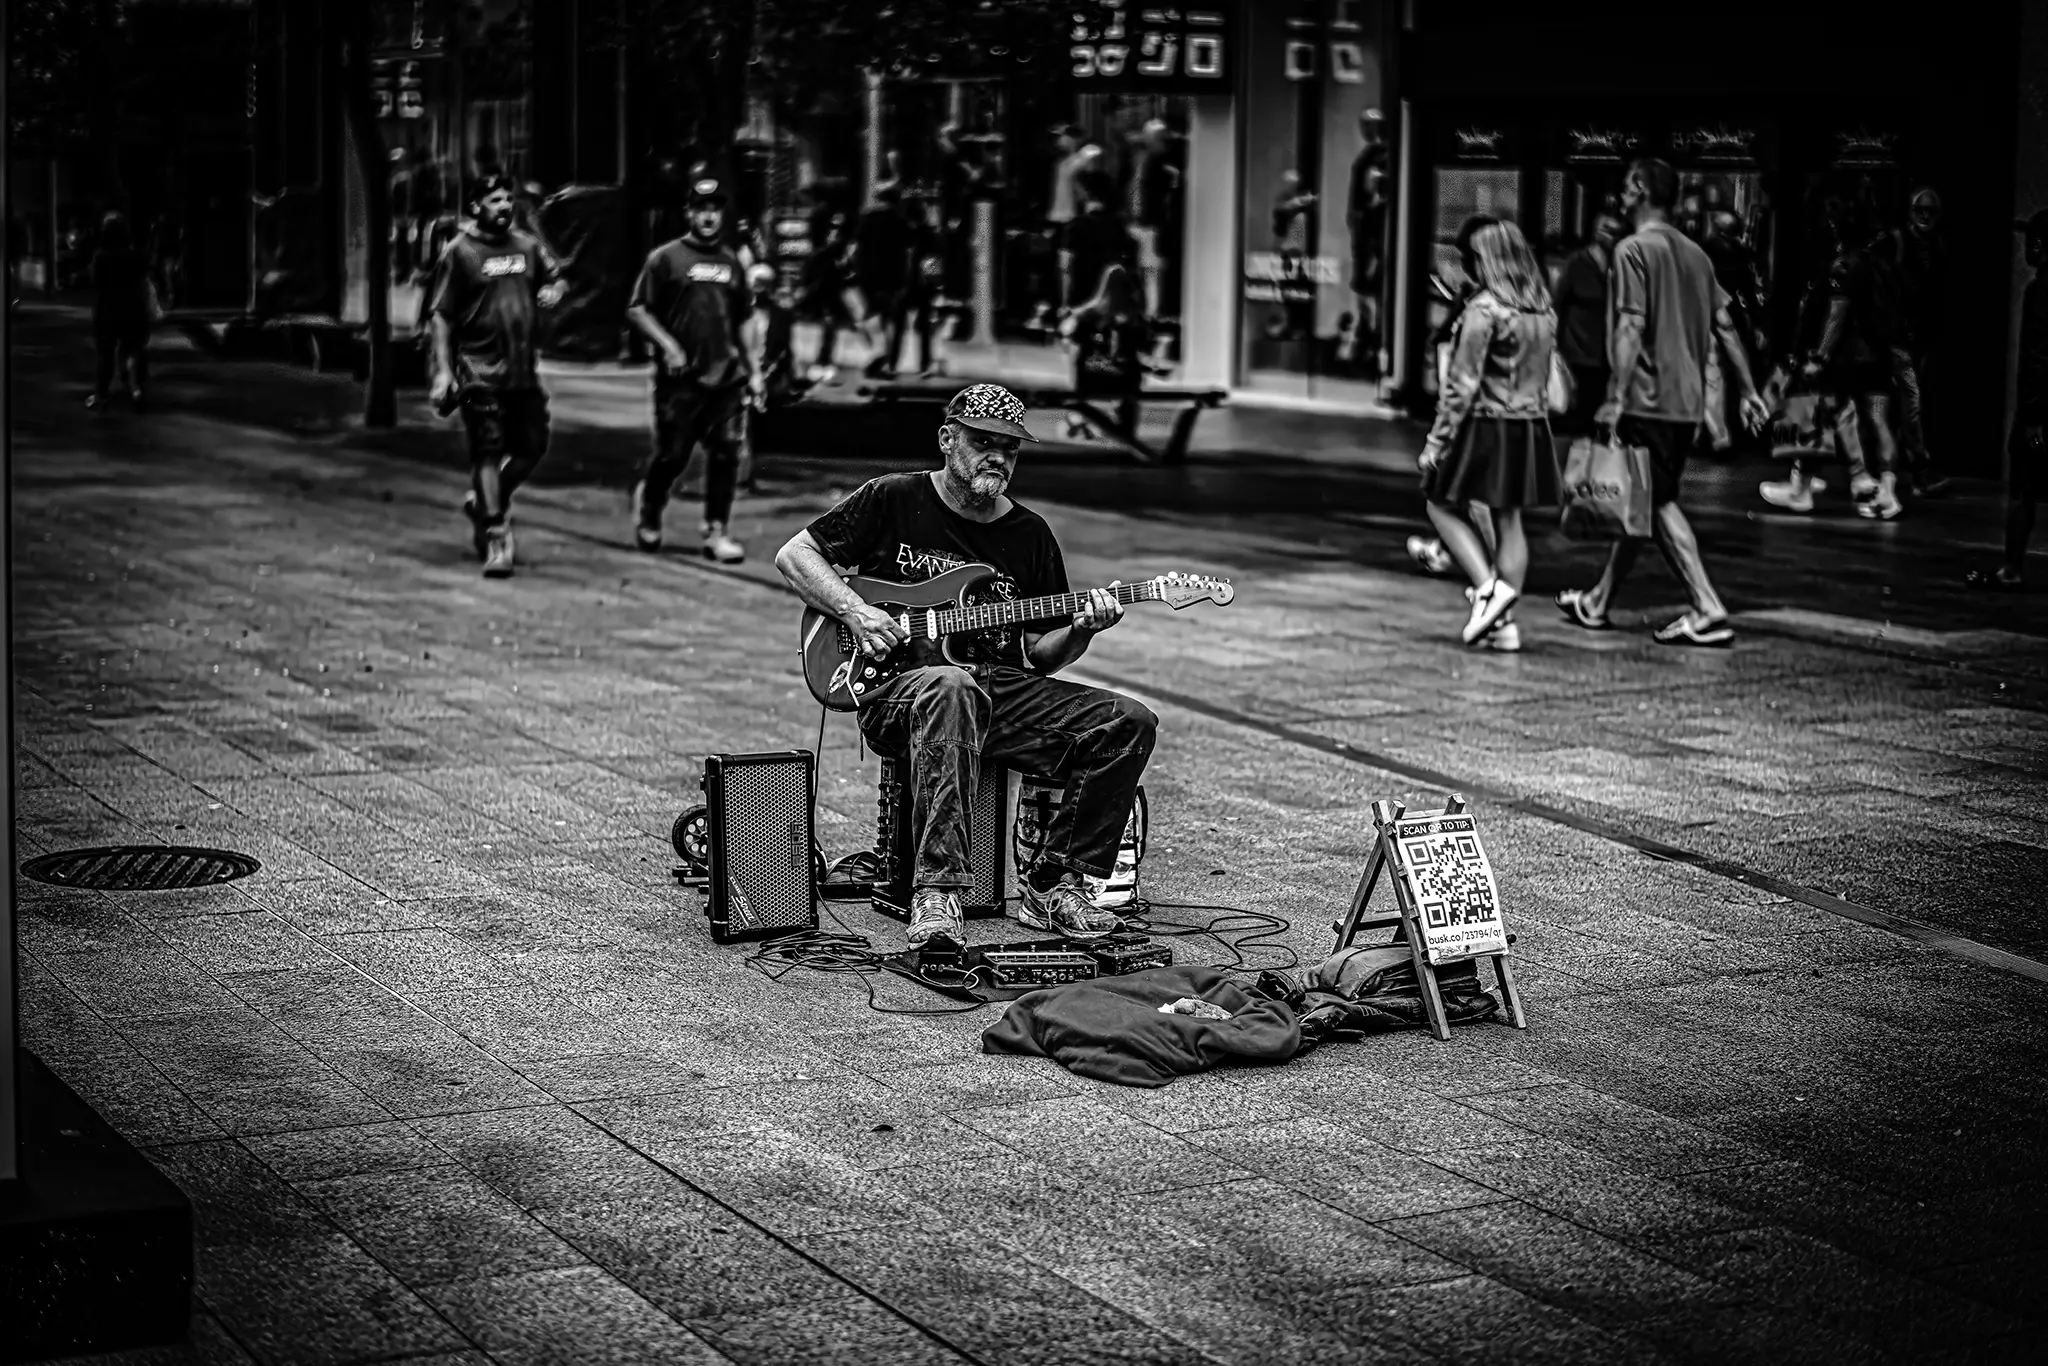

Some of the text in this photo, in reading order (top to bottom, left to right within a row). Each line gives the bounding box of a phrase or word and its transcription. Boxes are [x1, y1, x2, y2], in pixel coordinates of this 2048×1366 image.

[1404, 825, 1427, 836] SCAN
[1428, 823, 1443, 833] QR
[1443, 821, 1454, 830] TO
